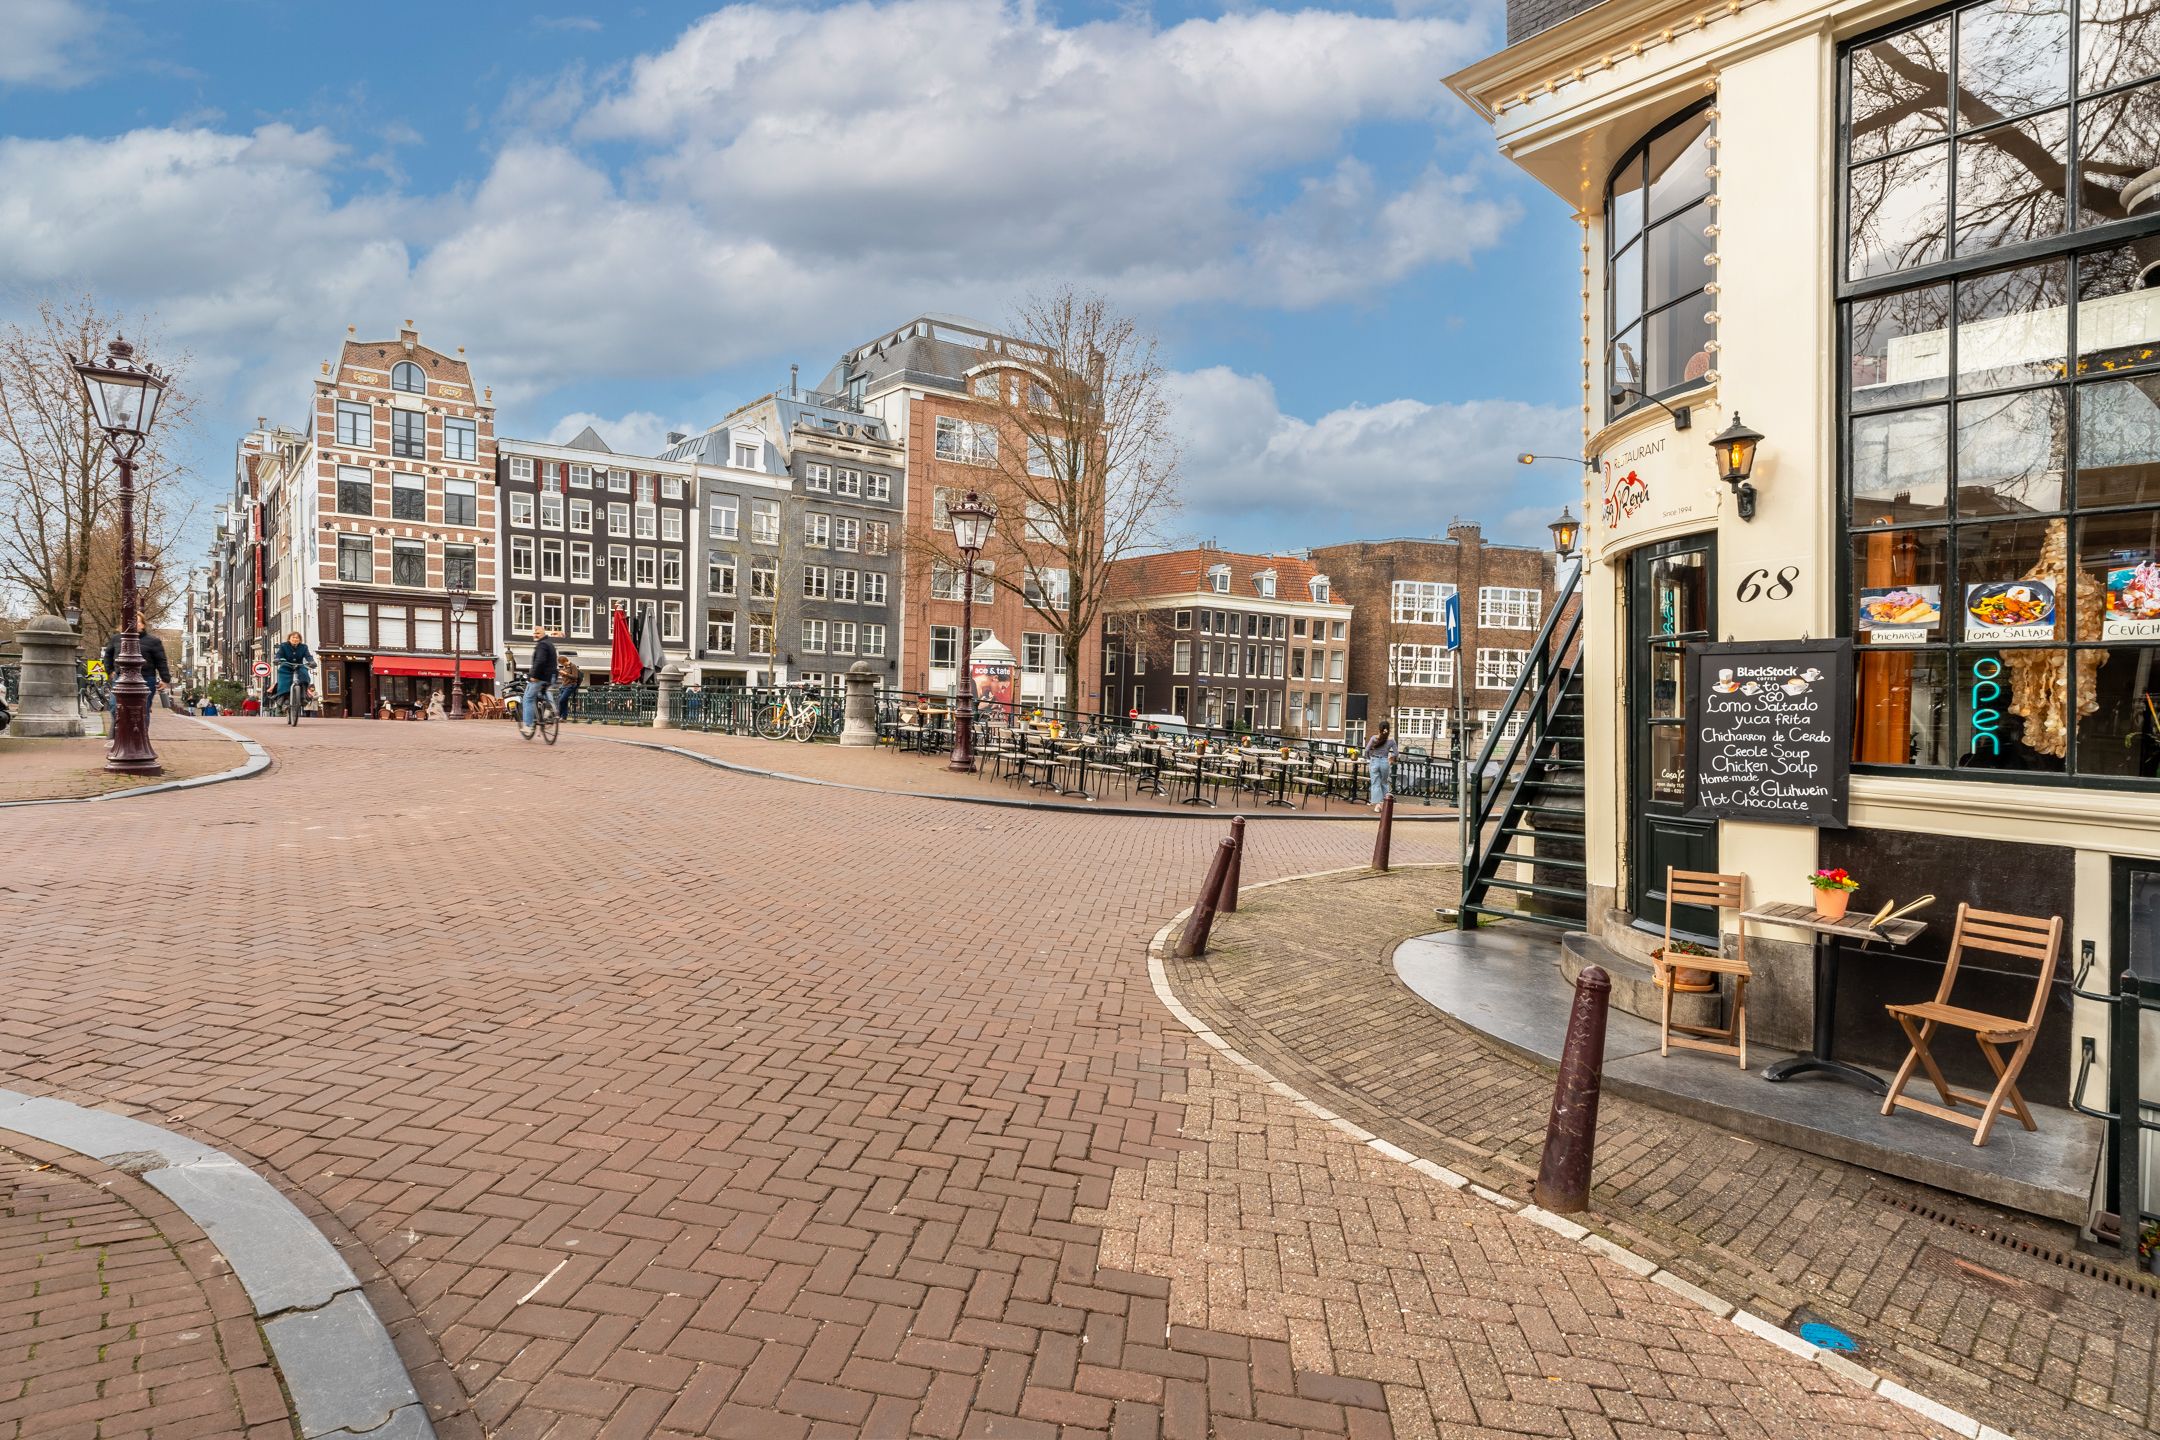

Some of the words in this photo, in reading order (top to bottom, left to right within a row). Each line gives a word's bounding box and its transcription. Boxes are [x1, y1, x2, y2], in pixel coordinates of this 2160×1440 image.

[1736, 565, 1800, 603] 68
[1966, 629, 2000, 641] LOMO
[989, 667, 996, 675] &
[1736, 666, 1797, 677] BlackStock
[1762, 681, 1780, 692] to
[1706, 694, 1752, 713] Lomo
[1754, 695, 1819, 712] Saltado
[1731, 715, 1771, 731] yuca
[1772, 730, 1786, 742] de
[1770, 743, 1811, 766] Soup
[1711, 755, 1769, 773] Chicken
[1770, 757, 1818, 779] Soup
[1661, 768, 1677, 780] Casa
[1700, 772, 1760, 785] Home-made
[1748, 786, 1760, 797] &
[1700, 790, 1731, 808] Hot
[1731, 789, 1809, 811] Chocolate
